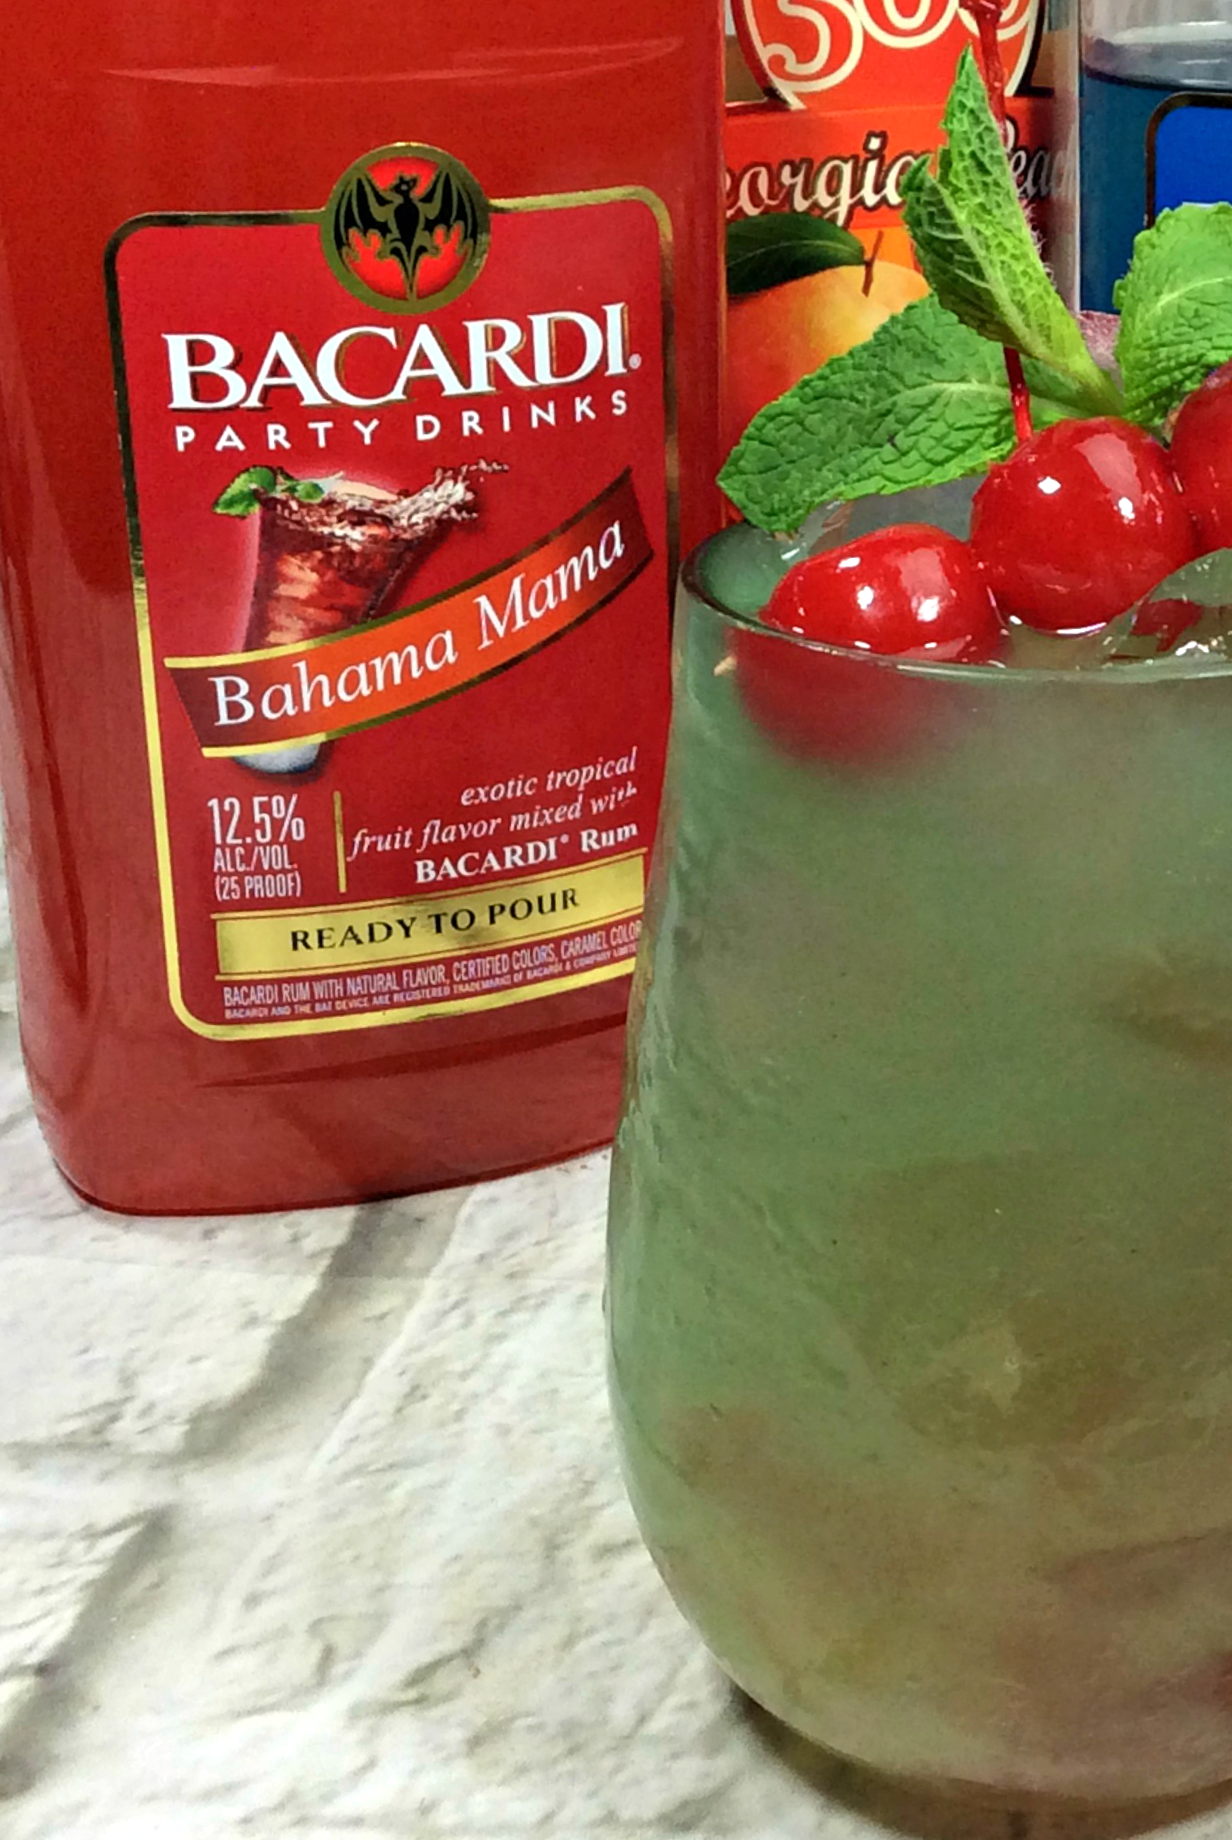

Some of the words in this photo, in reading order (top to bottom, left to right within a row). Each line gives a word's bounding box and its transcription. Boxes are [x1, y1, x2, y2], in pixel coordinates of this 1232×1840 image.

[174, 418, 381, 452] PARTY
[415, 389, 628, 441] DRINKS
[208, 628, 459, 726] Bahama
[473, 519, 626, 650] Mama
[461, 774, 539, 806] exotic
[545, 745, 638, 792] tropical
[207, 793, 305, 845] 12.5%
[346, 826, 413, 862] fruit
[415, 817, 502, 854] flavor
[509, 793, 583, 832] mixed
[590, 780, 638, 815] with
[580, 823, 639, 853] Rum
[213, 844, 299, 873] ALC./VOL.
[214, 873, 241, 902] (25
[244, 871, 302, 900] PROOF)
[289, 914, 418, 952] READY
[427, 908, 476, 935] TO
[487, 888, 581, 926] POUR
[223, 984, 280, 1007] BACARDI
[281, 980, 312, 1004] RUM
[312, 977, 344, 1001] WITH
[346, 971, 400, 998] NATURAL
[402, 963, 450, 989] FLAVOR,
[452, 953, 511, 982] CERTIFIED
[511, 943, 559, 970] COLORS,
[560, 930, 608, 960] CARAMEL
